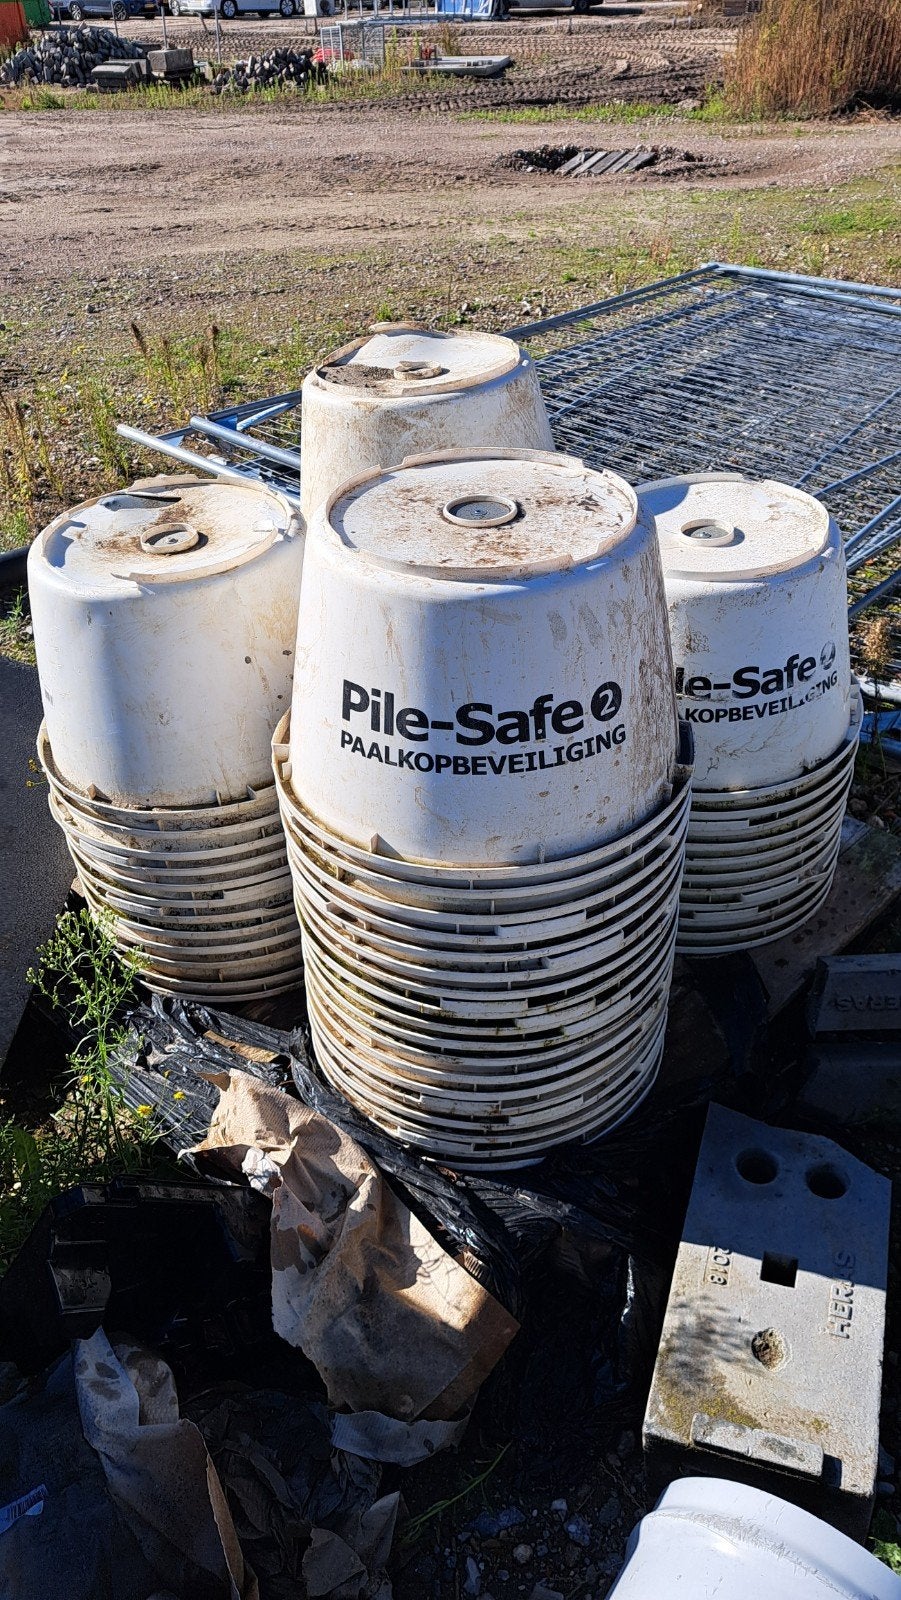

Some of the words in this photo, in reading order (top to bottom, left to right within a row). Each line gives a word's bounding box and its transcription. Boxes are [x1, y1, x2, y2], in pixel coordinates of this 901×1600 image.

[675, 653, 817, 701] le-Safe
[341, 679, 584, 746] Pile-Safe
[340, 723, 627, 776] PAALKOPBEVEILIGING
[834, 994, 901, 1012] ERAS
[828, 1250, 856, 1340] HERAS
